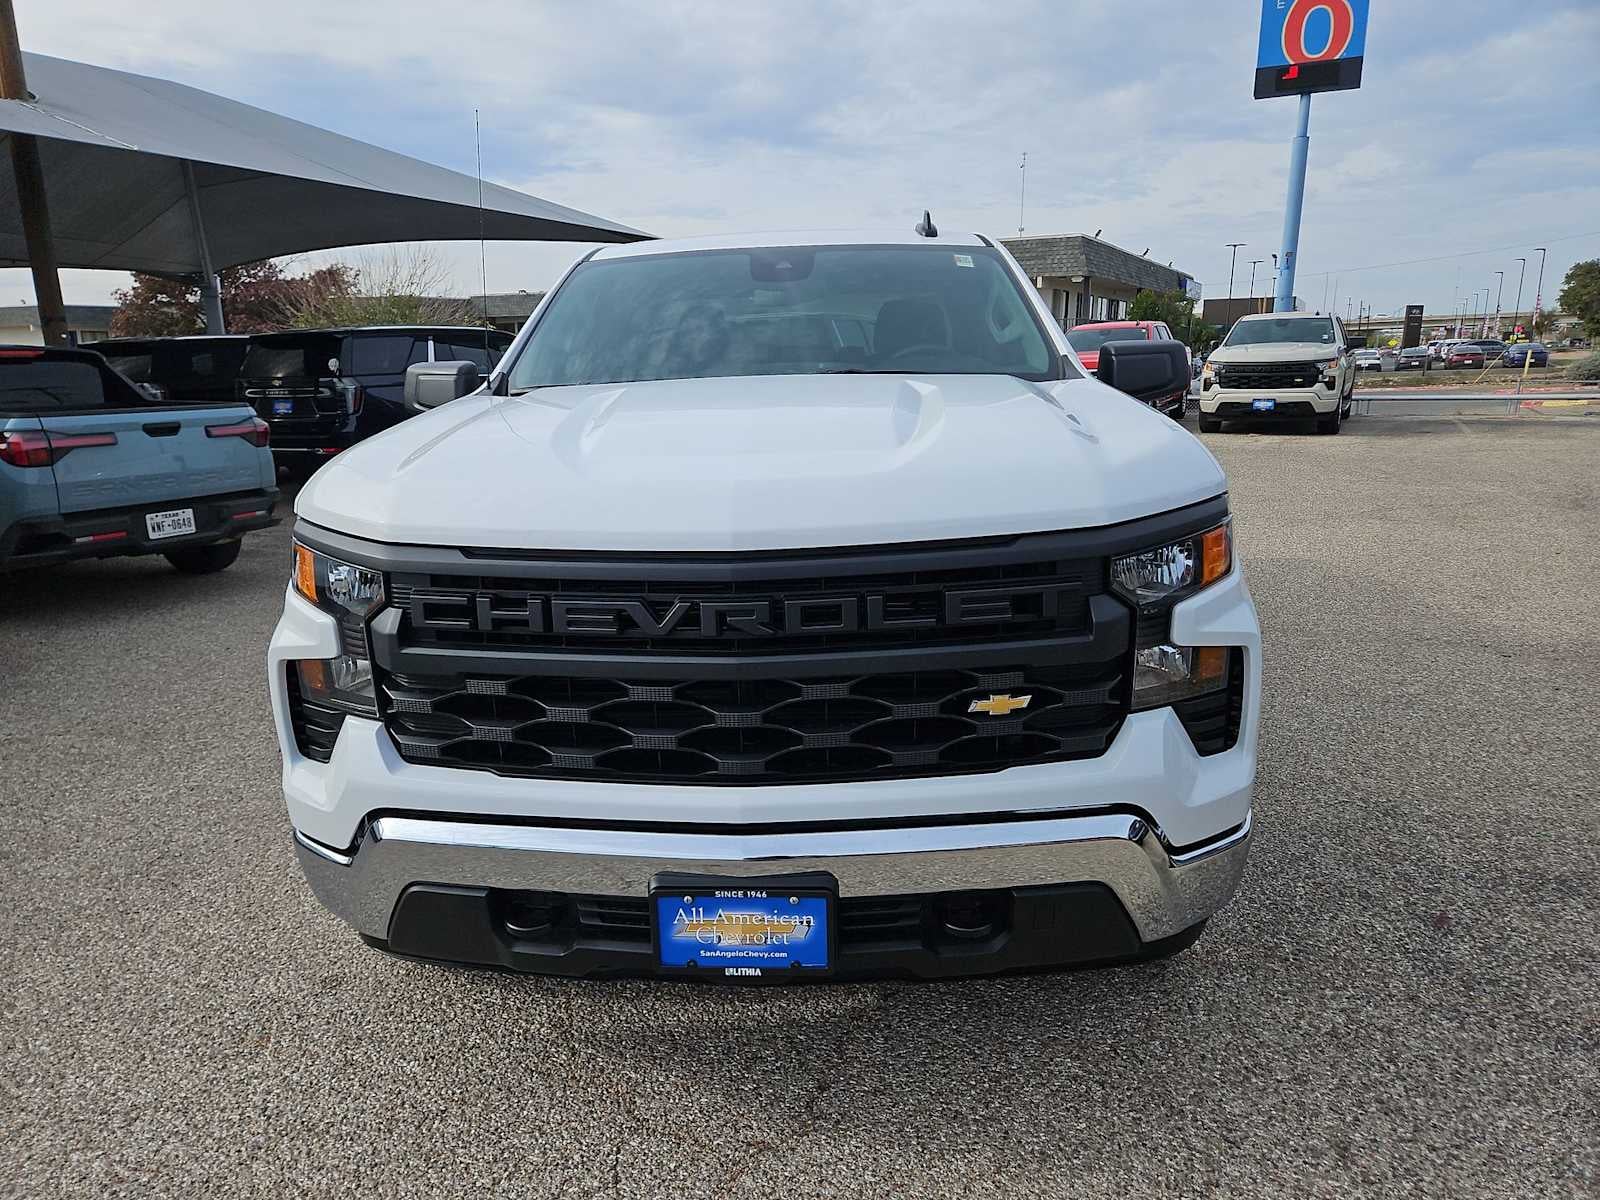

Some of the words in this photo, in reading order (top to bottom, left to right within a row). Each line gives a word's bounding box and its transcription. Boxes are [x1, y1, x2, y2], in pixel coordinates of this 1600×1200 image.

[408, 581, 1083, 636] CHEVROLET
[714, 890, 744, 898] SINCE
[747, 890, 767, 898] 1946
[673, 907, 704, 925] All
[713, 909, 815, 926] American
[695, 927, 790, 945] Chevrolet
[700, 950, 788, 959] SanAngeloChevy.com
